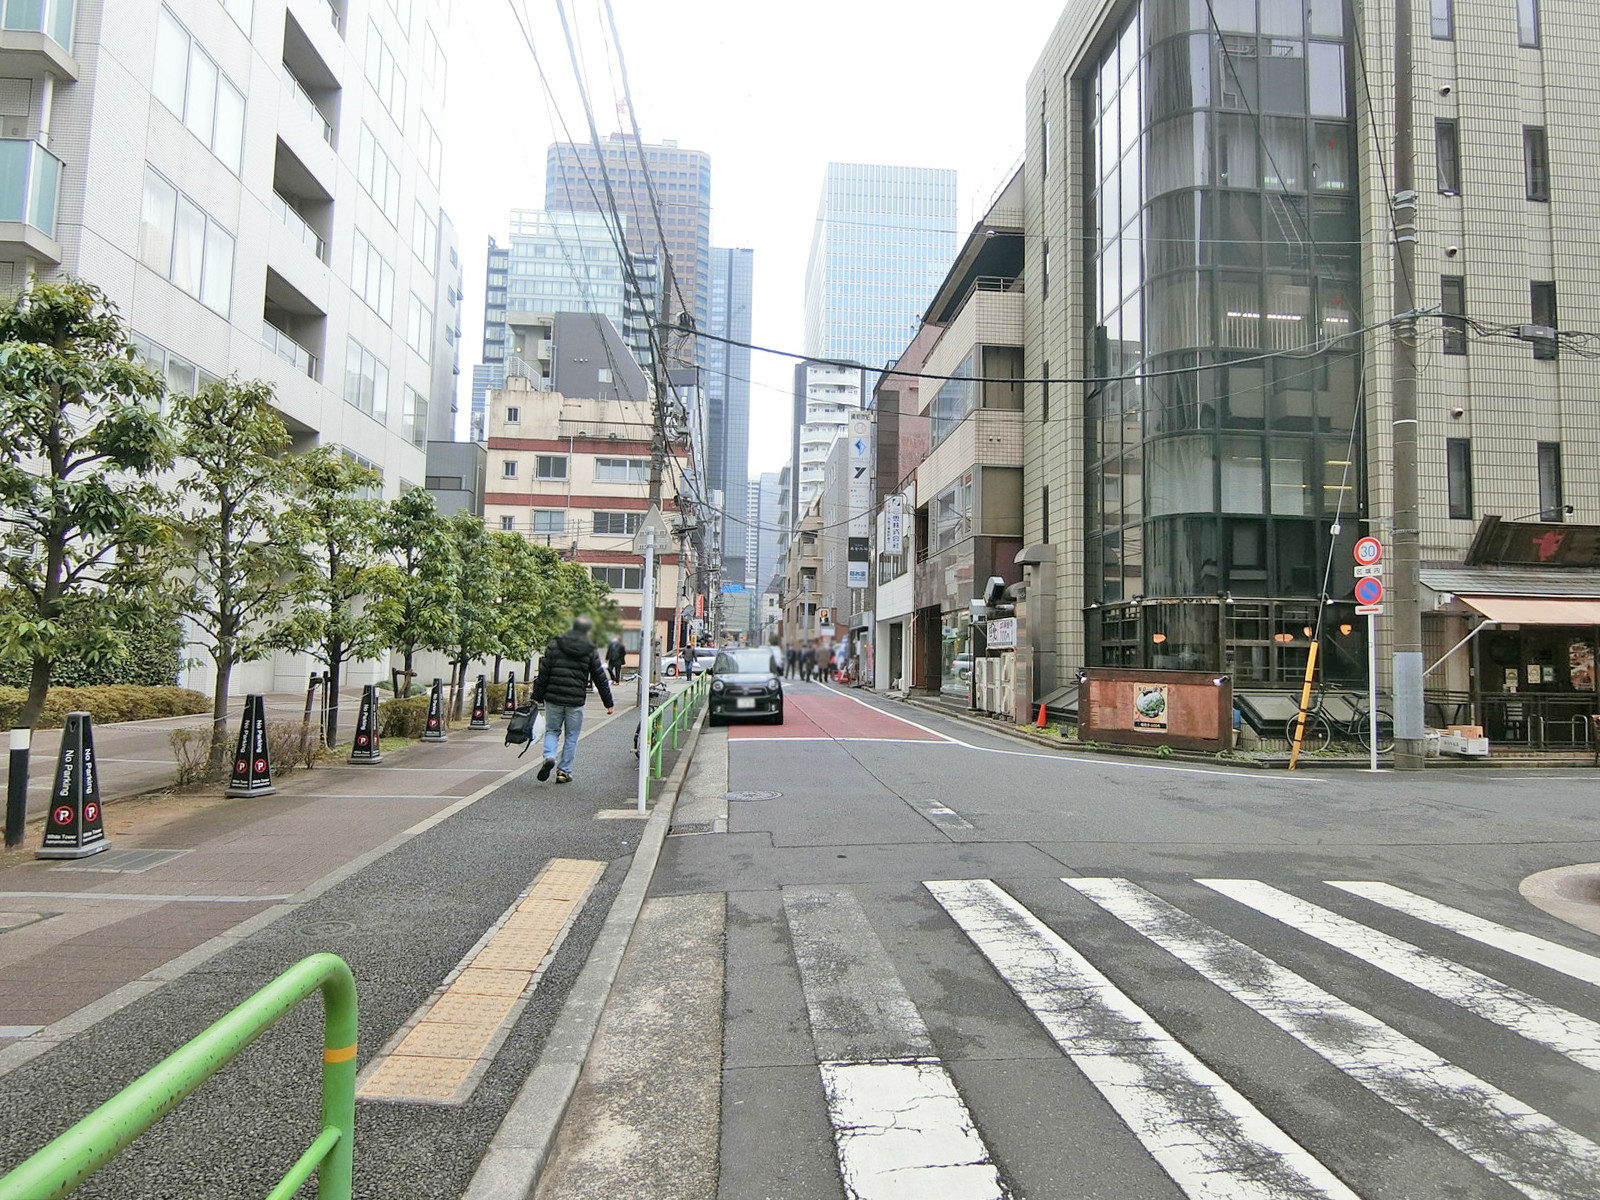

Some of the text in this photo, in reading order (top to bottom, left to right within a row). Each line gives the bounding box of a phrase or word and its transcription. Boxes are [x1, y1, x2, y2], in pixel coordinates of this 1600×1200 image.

[1360, 545, 1376, 558] 30
[1356, 567, 1380, 575] 区域内
[240, 720, 250, 753] No Parking
[255, 720, 263, 753] No Parking
[59, 749, 75, 797] No Parking
[84, 748, 93, 795] No Parking
